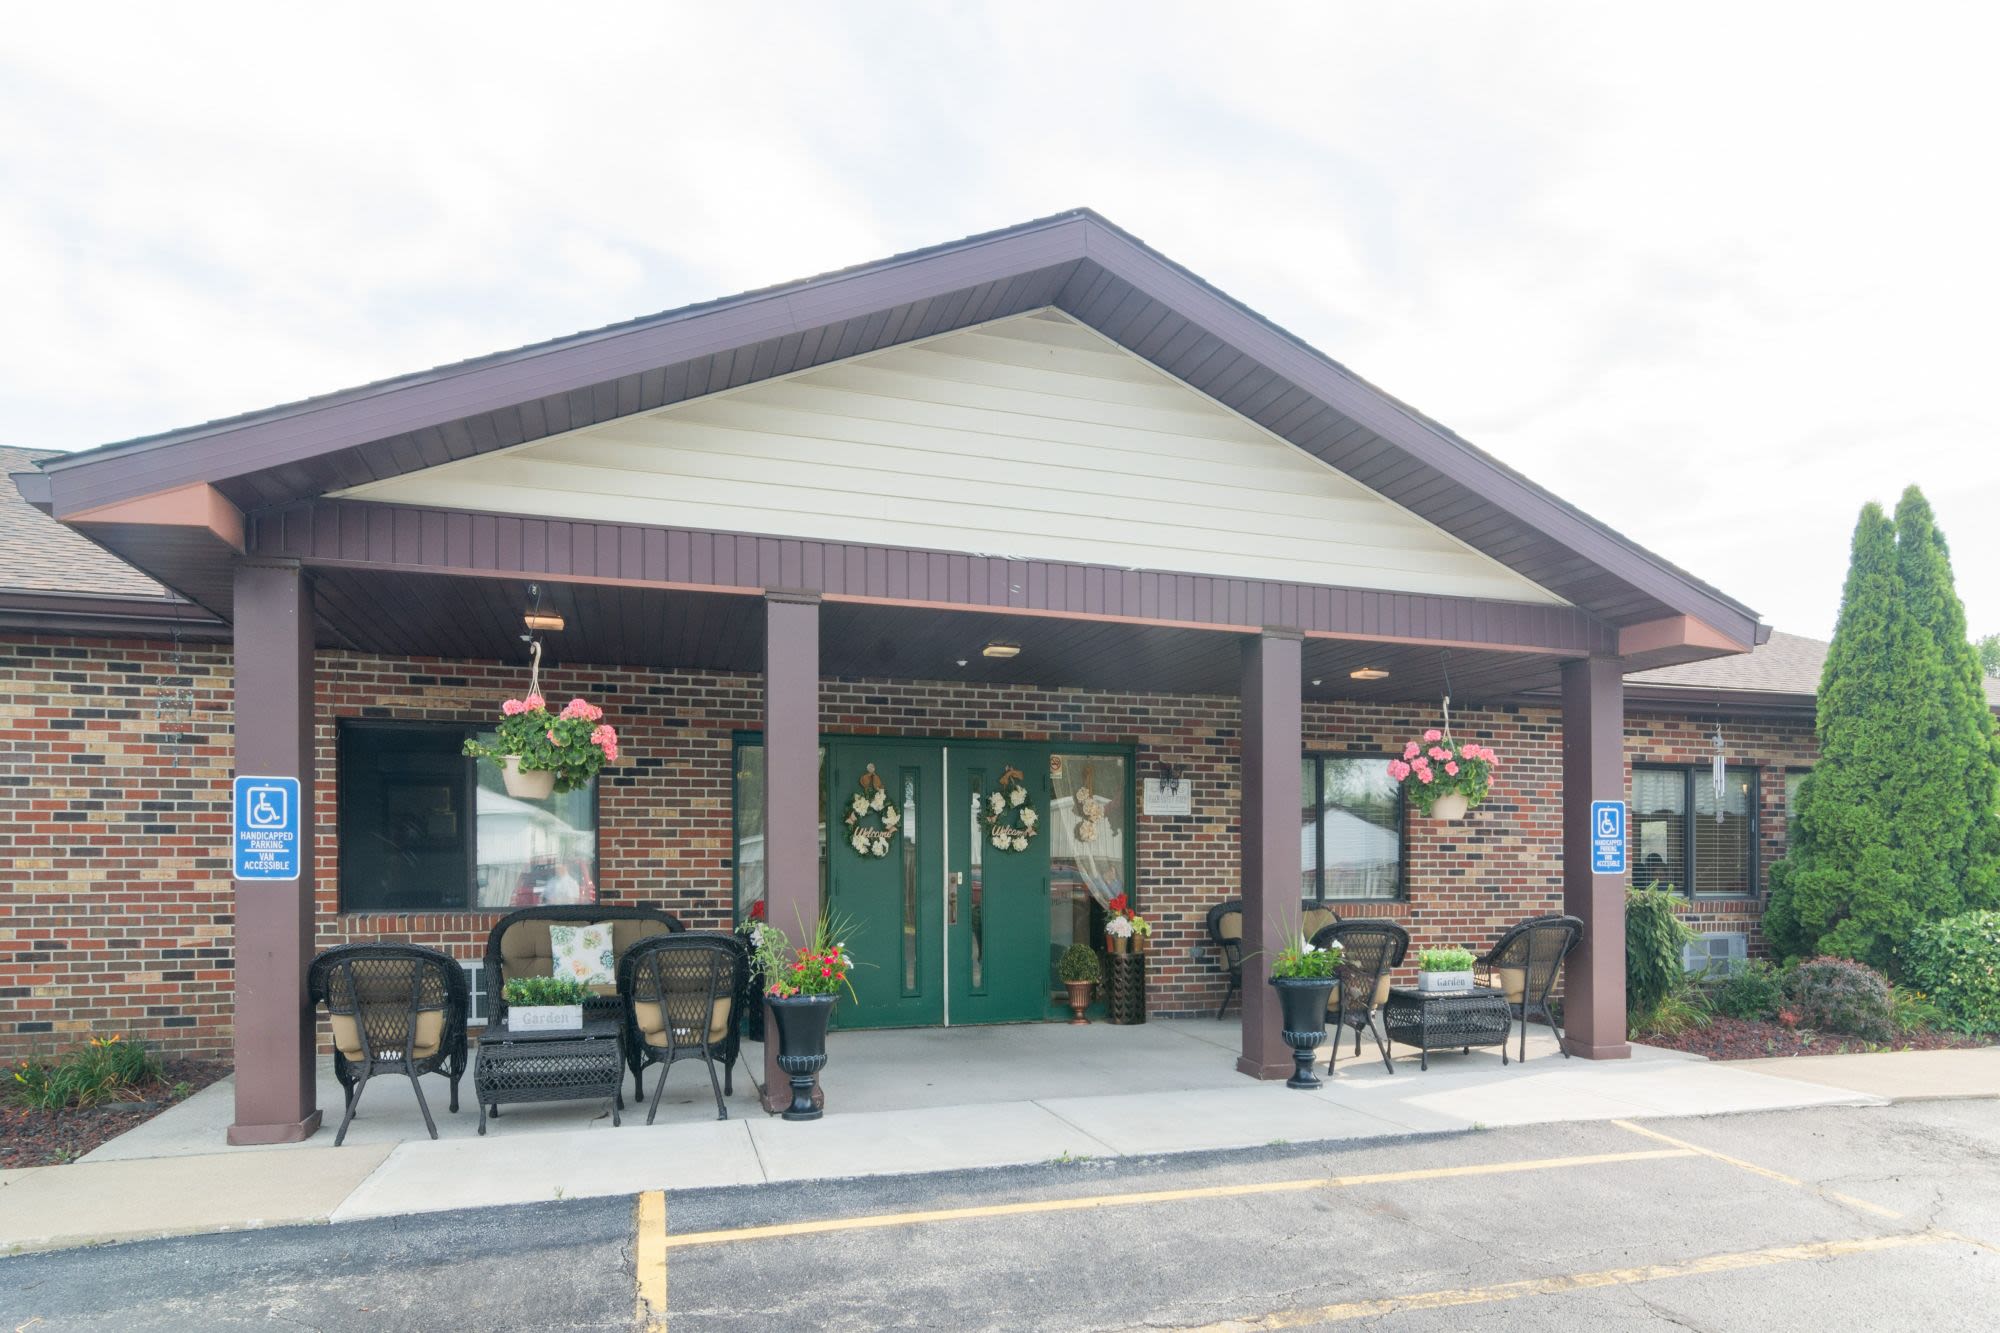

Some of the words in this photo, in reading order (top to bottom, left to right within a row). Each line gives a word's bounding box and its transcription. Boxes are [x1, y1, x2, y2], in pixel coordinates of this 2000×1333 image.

[992, 825, 1028, 836] Welcom
[240, 831, 294, 841] HANDICAPPED
[250, 840, 284, 849] PARKING
[259, 852, 275, 861] VAN
[244, 861, 290, 870] ACCESSIBLE
[1436, 976, 1466, 987] Garden
[522, 1011, 569, 1025] Garden
